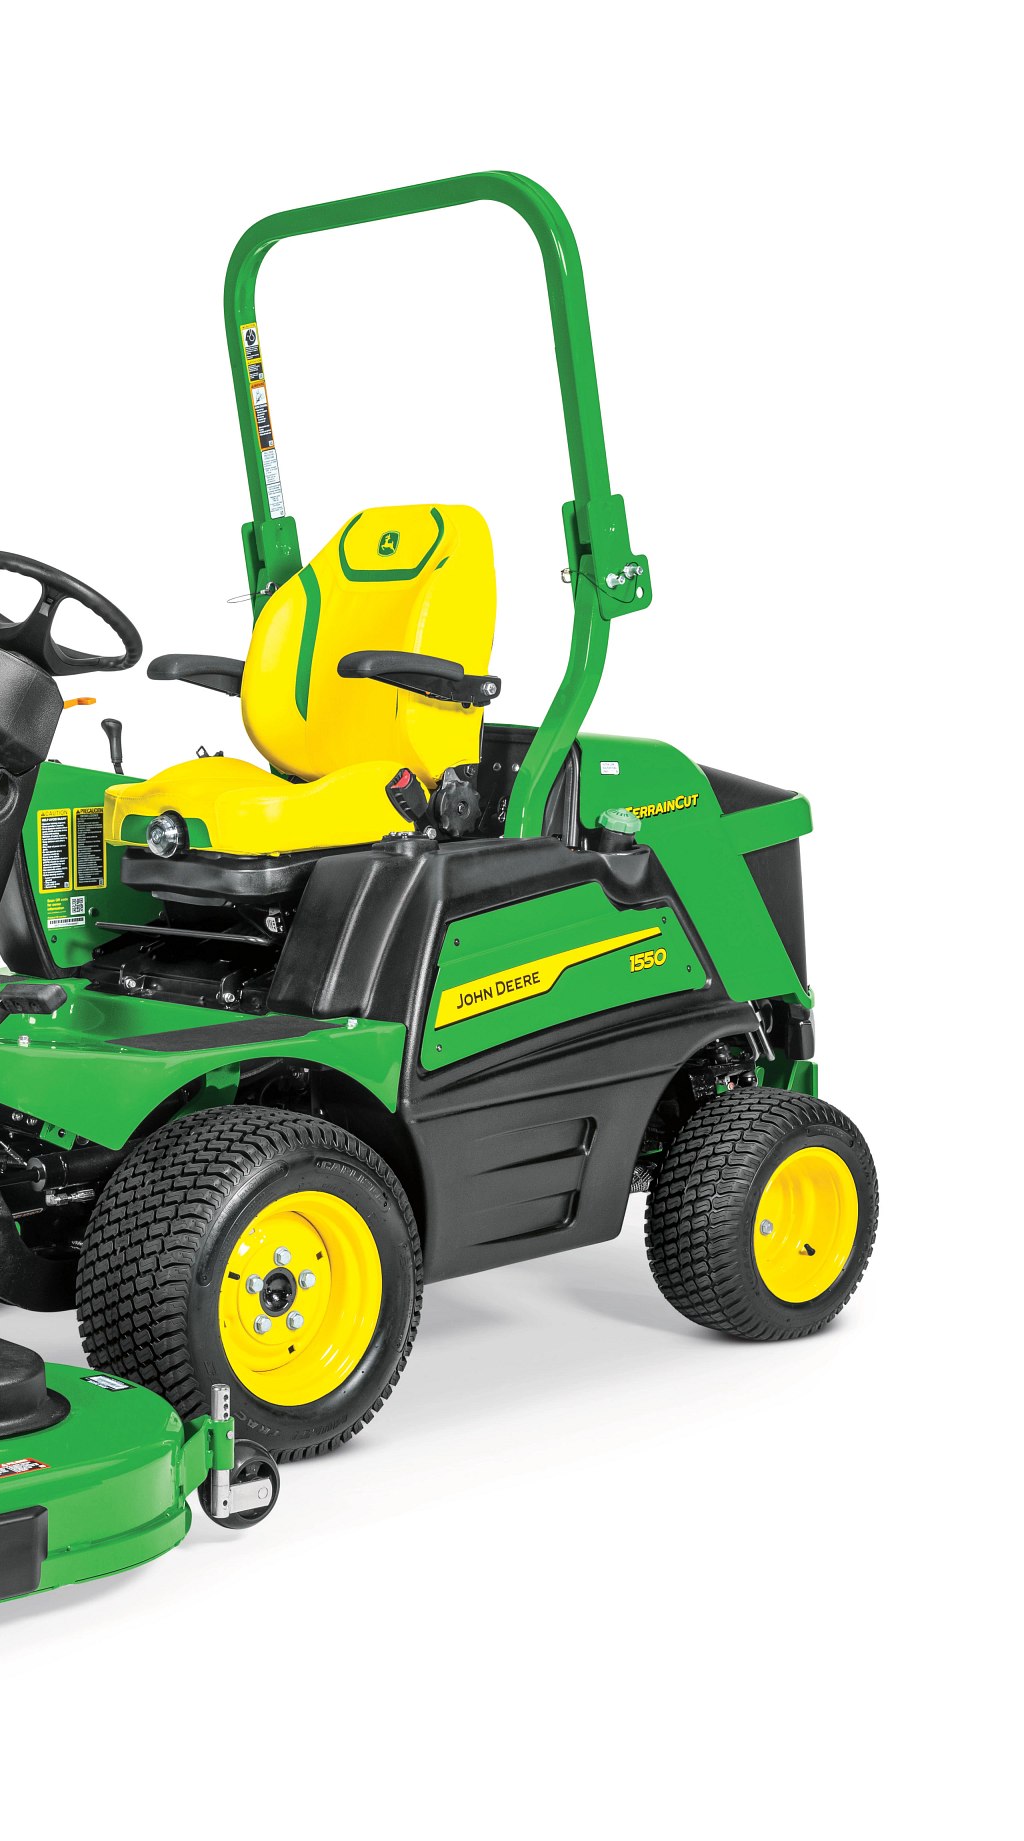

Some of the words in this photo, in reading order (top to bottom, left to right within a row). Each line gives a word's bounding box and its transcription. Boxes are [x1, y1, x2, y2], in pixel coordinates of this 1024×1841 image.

[629, 948, 667, 973] 1550
[456, 986, 493, 1009] JOHN
[496, 971, 541, 997] DEERE
